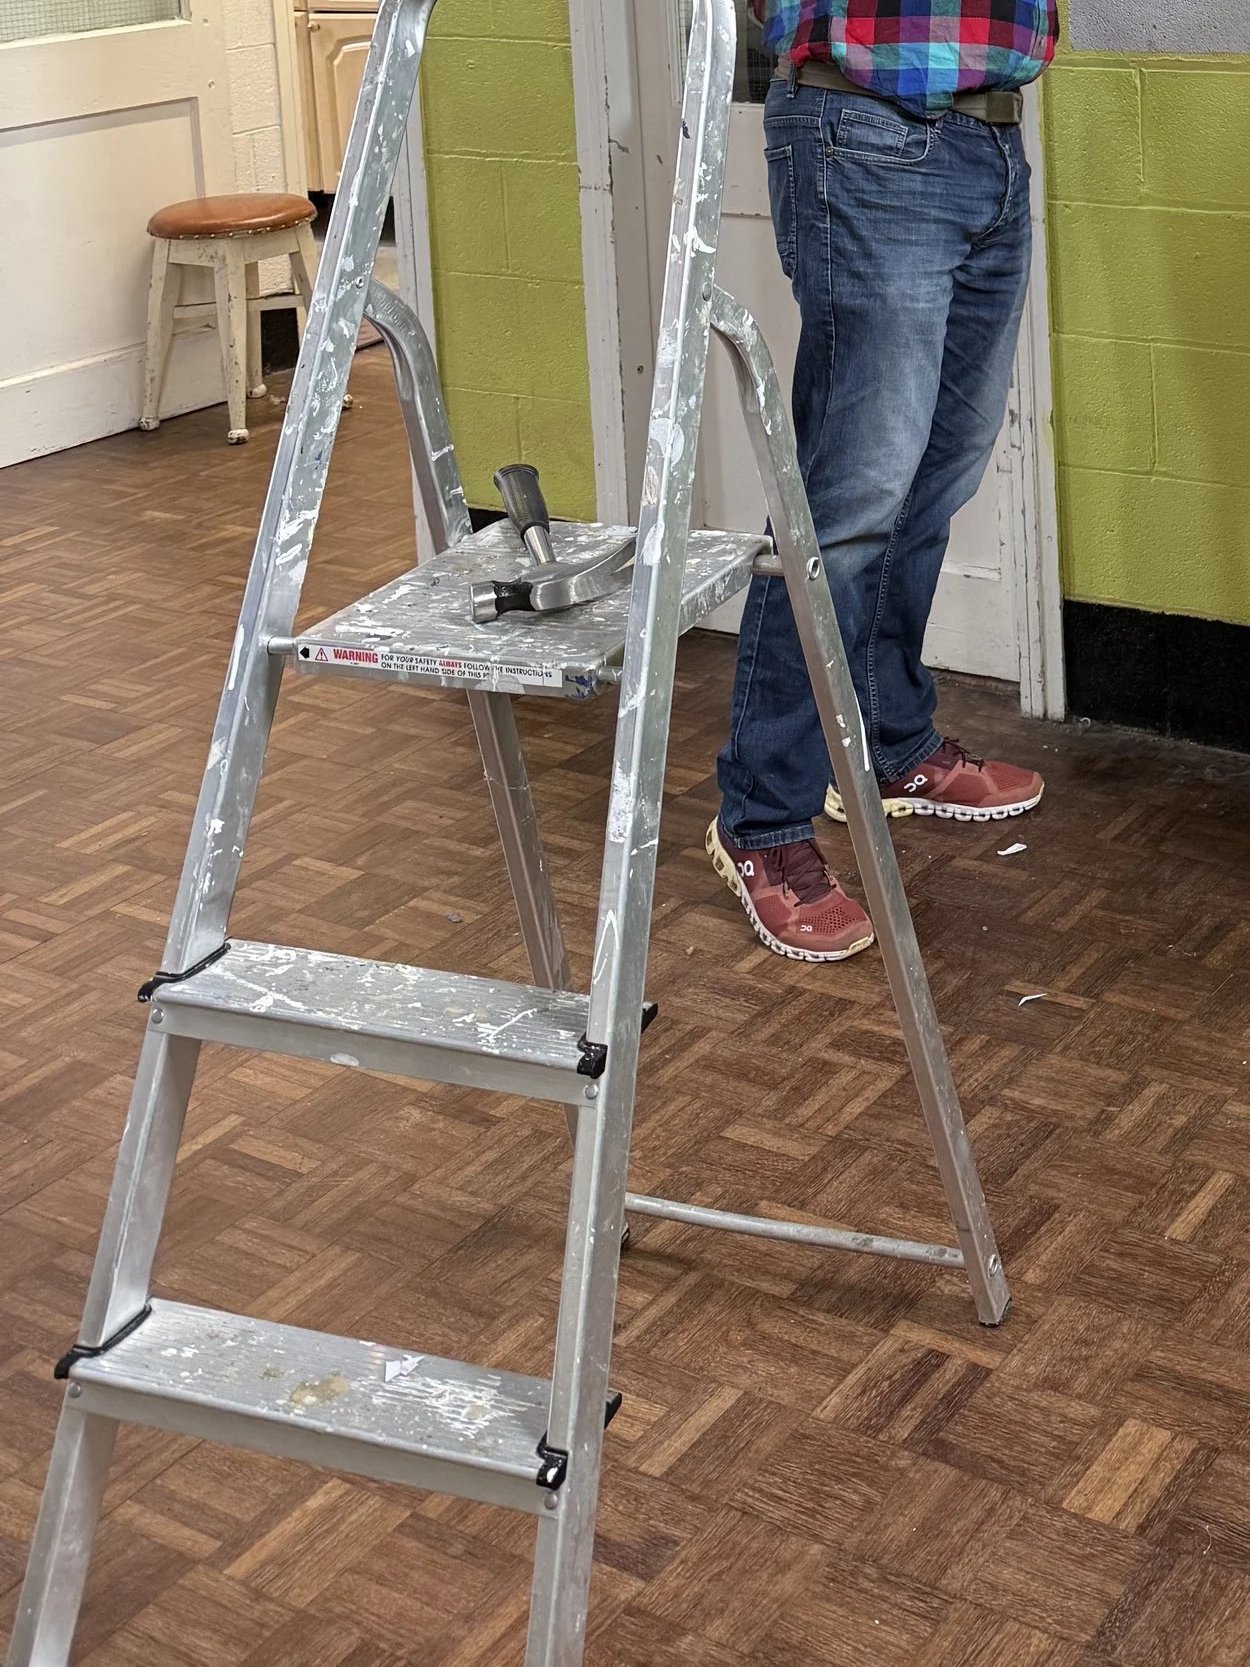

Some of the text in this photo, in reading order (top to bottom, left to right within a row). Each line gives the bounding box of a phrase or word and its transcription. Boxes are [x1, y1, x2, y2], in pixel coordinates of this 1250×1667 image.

[333, 648, 379, 664] WARNING
[381, 653, 394, 662] FOR
[396, 655, 414, 664] YOUR
[415, 657, 437, 667] SAFETY
[464, 662, 490, 672] FOLLOW
[381, 661, 393, 669] ON
[394, 662, 405, 671] THE
[406, 664, 419, 673] LEFT
[420, 666, 439, 674] HAND
[441, 668, 455, 676] SIDE
[457, 669, 466, 677] OF
[468, 670, 481, 679] THIS
